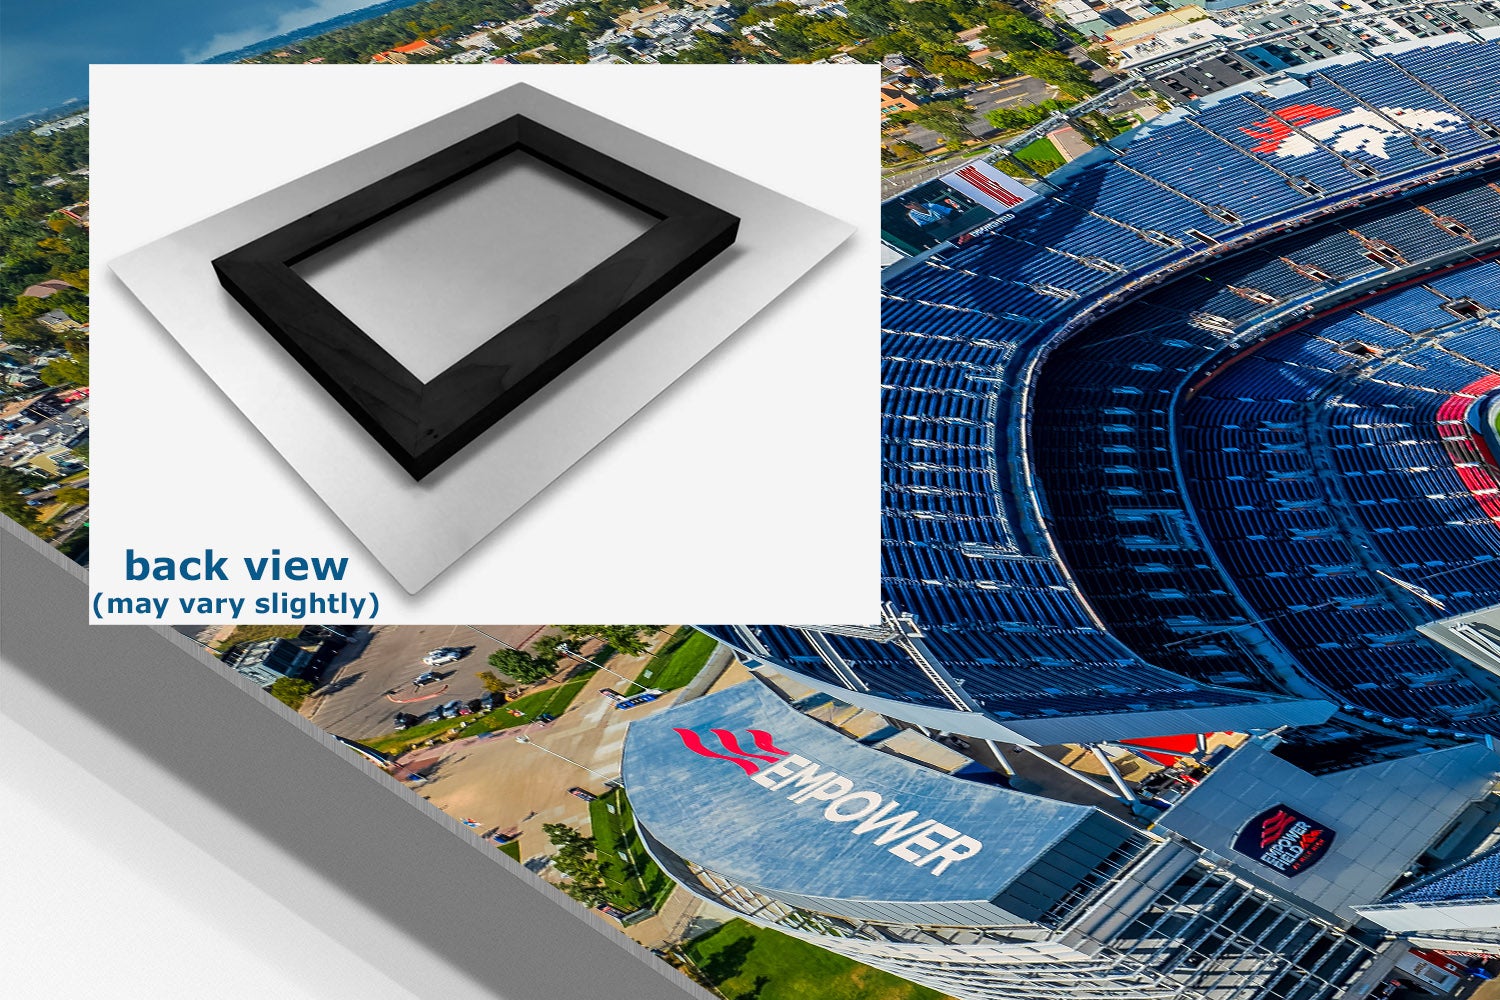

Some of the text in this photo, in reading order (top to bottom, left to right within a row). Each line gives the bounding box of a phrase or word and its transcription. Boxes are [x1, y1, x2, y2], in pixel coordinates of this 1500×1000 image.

[750, 753, 983, 877] EMPOWER
[1260, 821, 1312, 863] EMPOWER
[1270, 844, 1305, 871] FIELD
